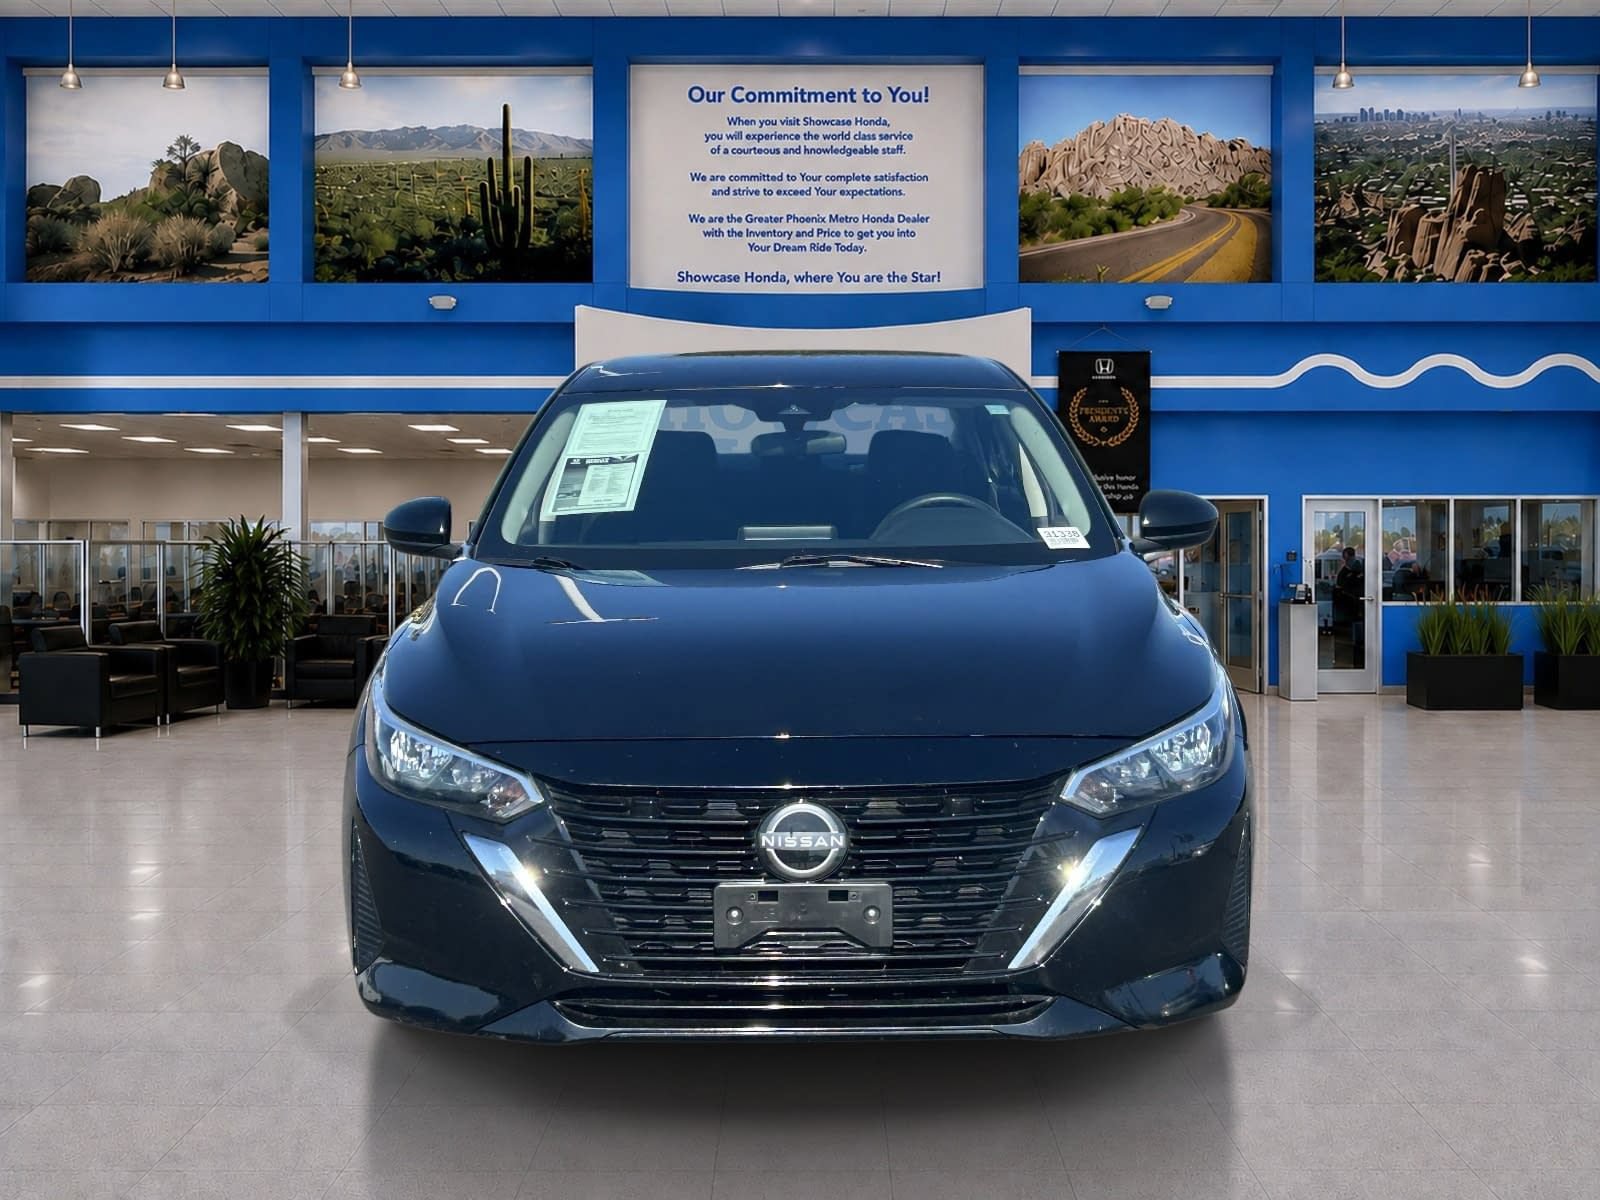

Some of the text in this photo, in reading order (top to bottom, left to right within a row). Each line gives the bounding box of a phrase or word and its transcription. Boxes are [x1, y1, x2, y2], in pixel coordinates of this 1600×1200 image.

[687, 85, 929, 104] Our Commitment to You!
[726, 115, 891, 129] When you visit Showcase Honda,
[704, 130, 914, 144] you will experience the world class service
[709, 144, 722, 156] of
[722, 147, 730, 156] a
[730, 146, 782, 156] courteous
[782, 144, 802, 156] and
[689, 171, 929, 185] We are committed to Your complete satisfaction
[711, 185, 906, 200] and strive to exceed Your expectations.
[687, 212, 931, 225] We are the Greater Phoenix Metro Honda Dealer
[701, 227, 917, 241] with the Inventory and Price to get you into
[747, 241, 868, 255] Your Dream Ride Today.
[676, 270, 941, 286] Showcase Honda, where You are the Star!
[760, 835, 845, 848] NISSAN
